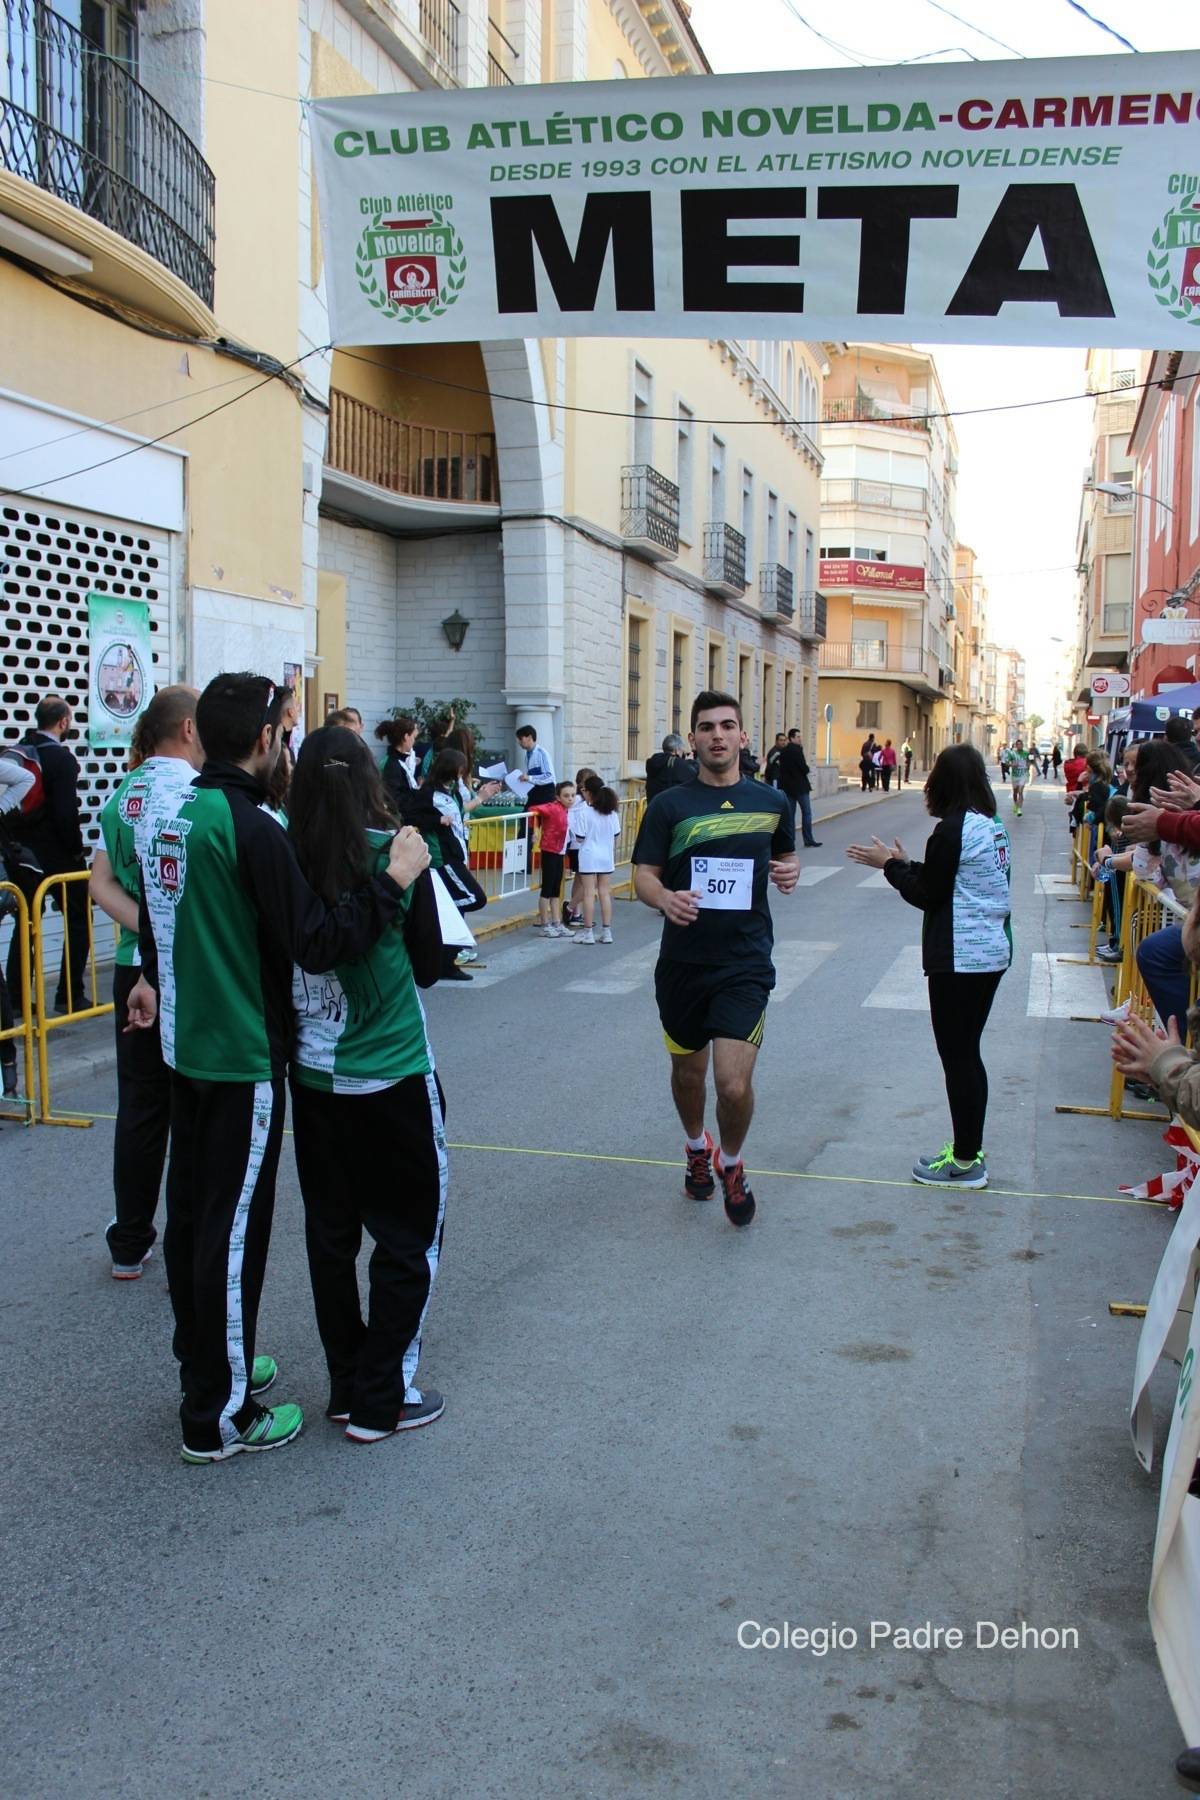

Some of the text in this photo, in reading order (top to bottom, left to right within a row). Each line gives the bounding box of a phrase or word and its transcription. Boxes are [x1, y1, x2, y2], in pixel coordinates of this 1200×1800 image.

[333, 91, 1200, 158] CLUB ATLÉTICO NOVELDA-CARMEN
[489, 146, 1123, 182] DESDE 1993 CON EL ATLETISMO NOVELDENSE
[360, 193, 454, 215] Club Atlético
[374, 233, 445, 257] Novelda
[489, 181, 1117, 318] META
[389, 288, 437, 299] CARMENCITA
[707, 878, 737, 894] 507
